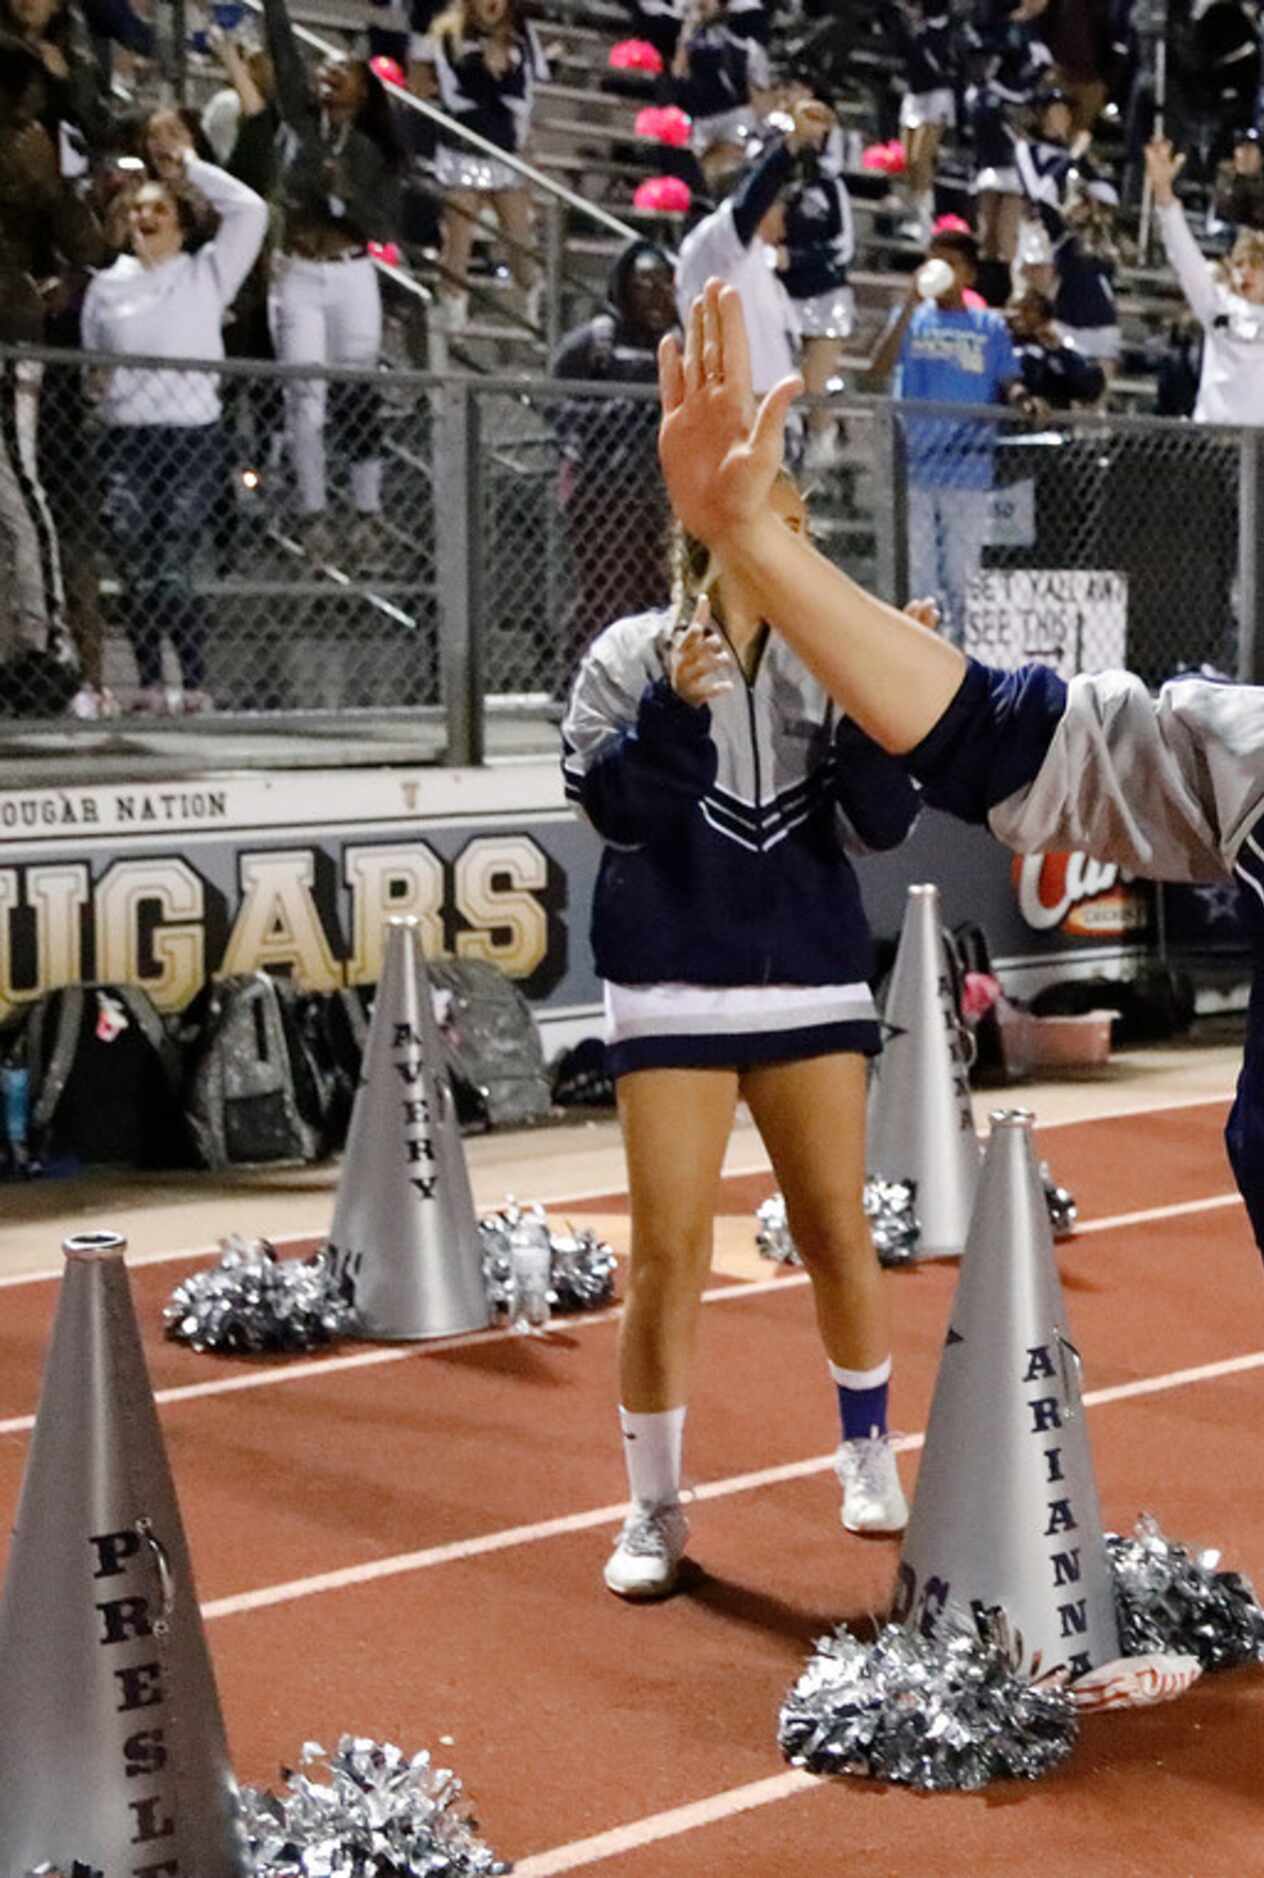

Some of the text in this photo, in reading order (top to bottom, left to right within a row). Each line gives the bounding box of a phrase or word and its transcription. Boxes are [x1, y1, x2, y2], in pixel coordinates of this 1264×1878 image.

[114, 789, 228, 823] NATION
[393, 1023, 438, 1200] AVERY
[1022, 1345, 1094, 1682] ARIANNA
